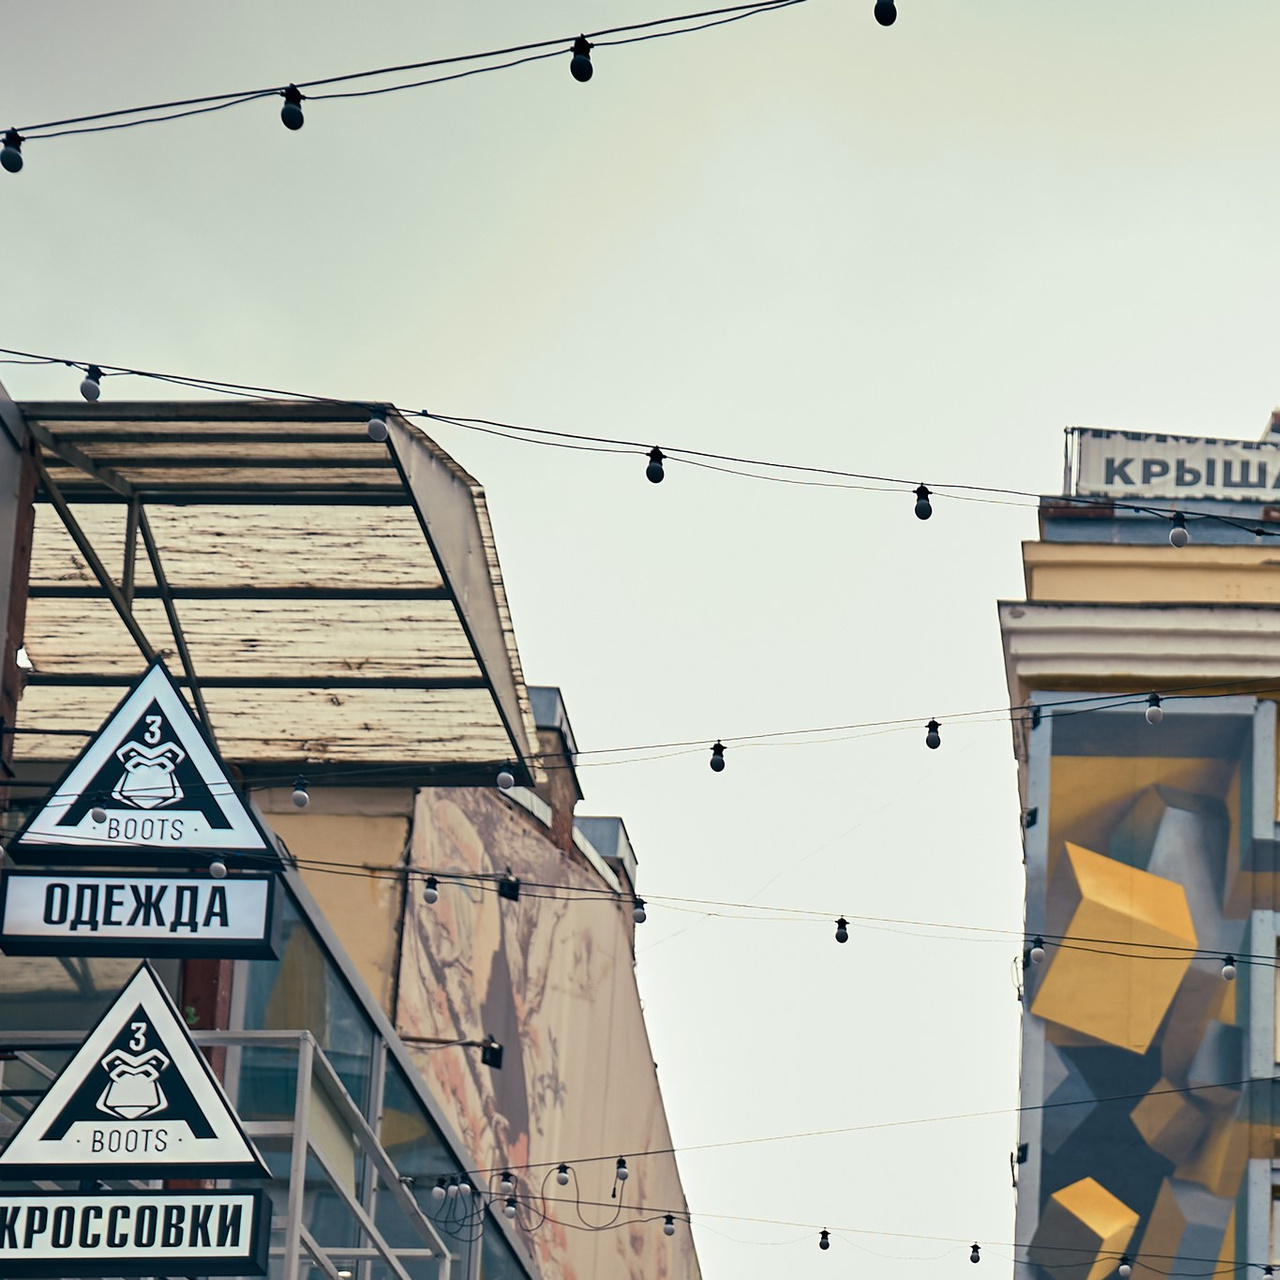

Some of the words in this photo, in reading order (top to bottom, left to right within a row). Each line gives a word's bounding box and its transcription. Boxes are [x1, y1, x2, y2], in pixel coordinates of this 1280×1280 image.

[144, 715, 162, 743] 3
[107, 816, 184, 842] BOOTS
[43, 882, 230, 932] ОДЕЖДА
[130, 1021, 147, 1051] 3
[91, 1128, 169, 1154] BOOTS
[0, 1203, 243, 1250] КРОССОВКИ
